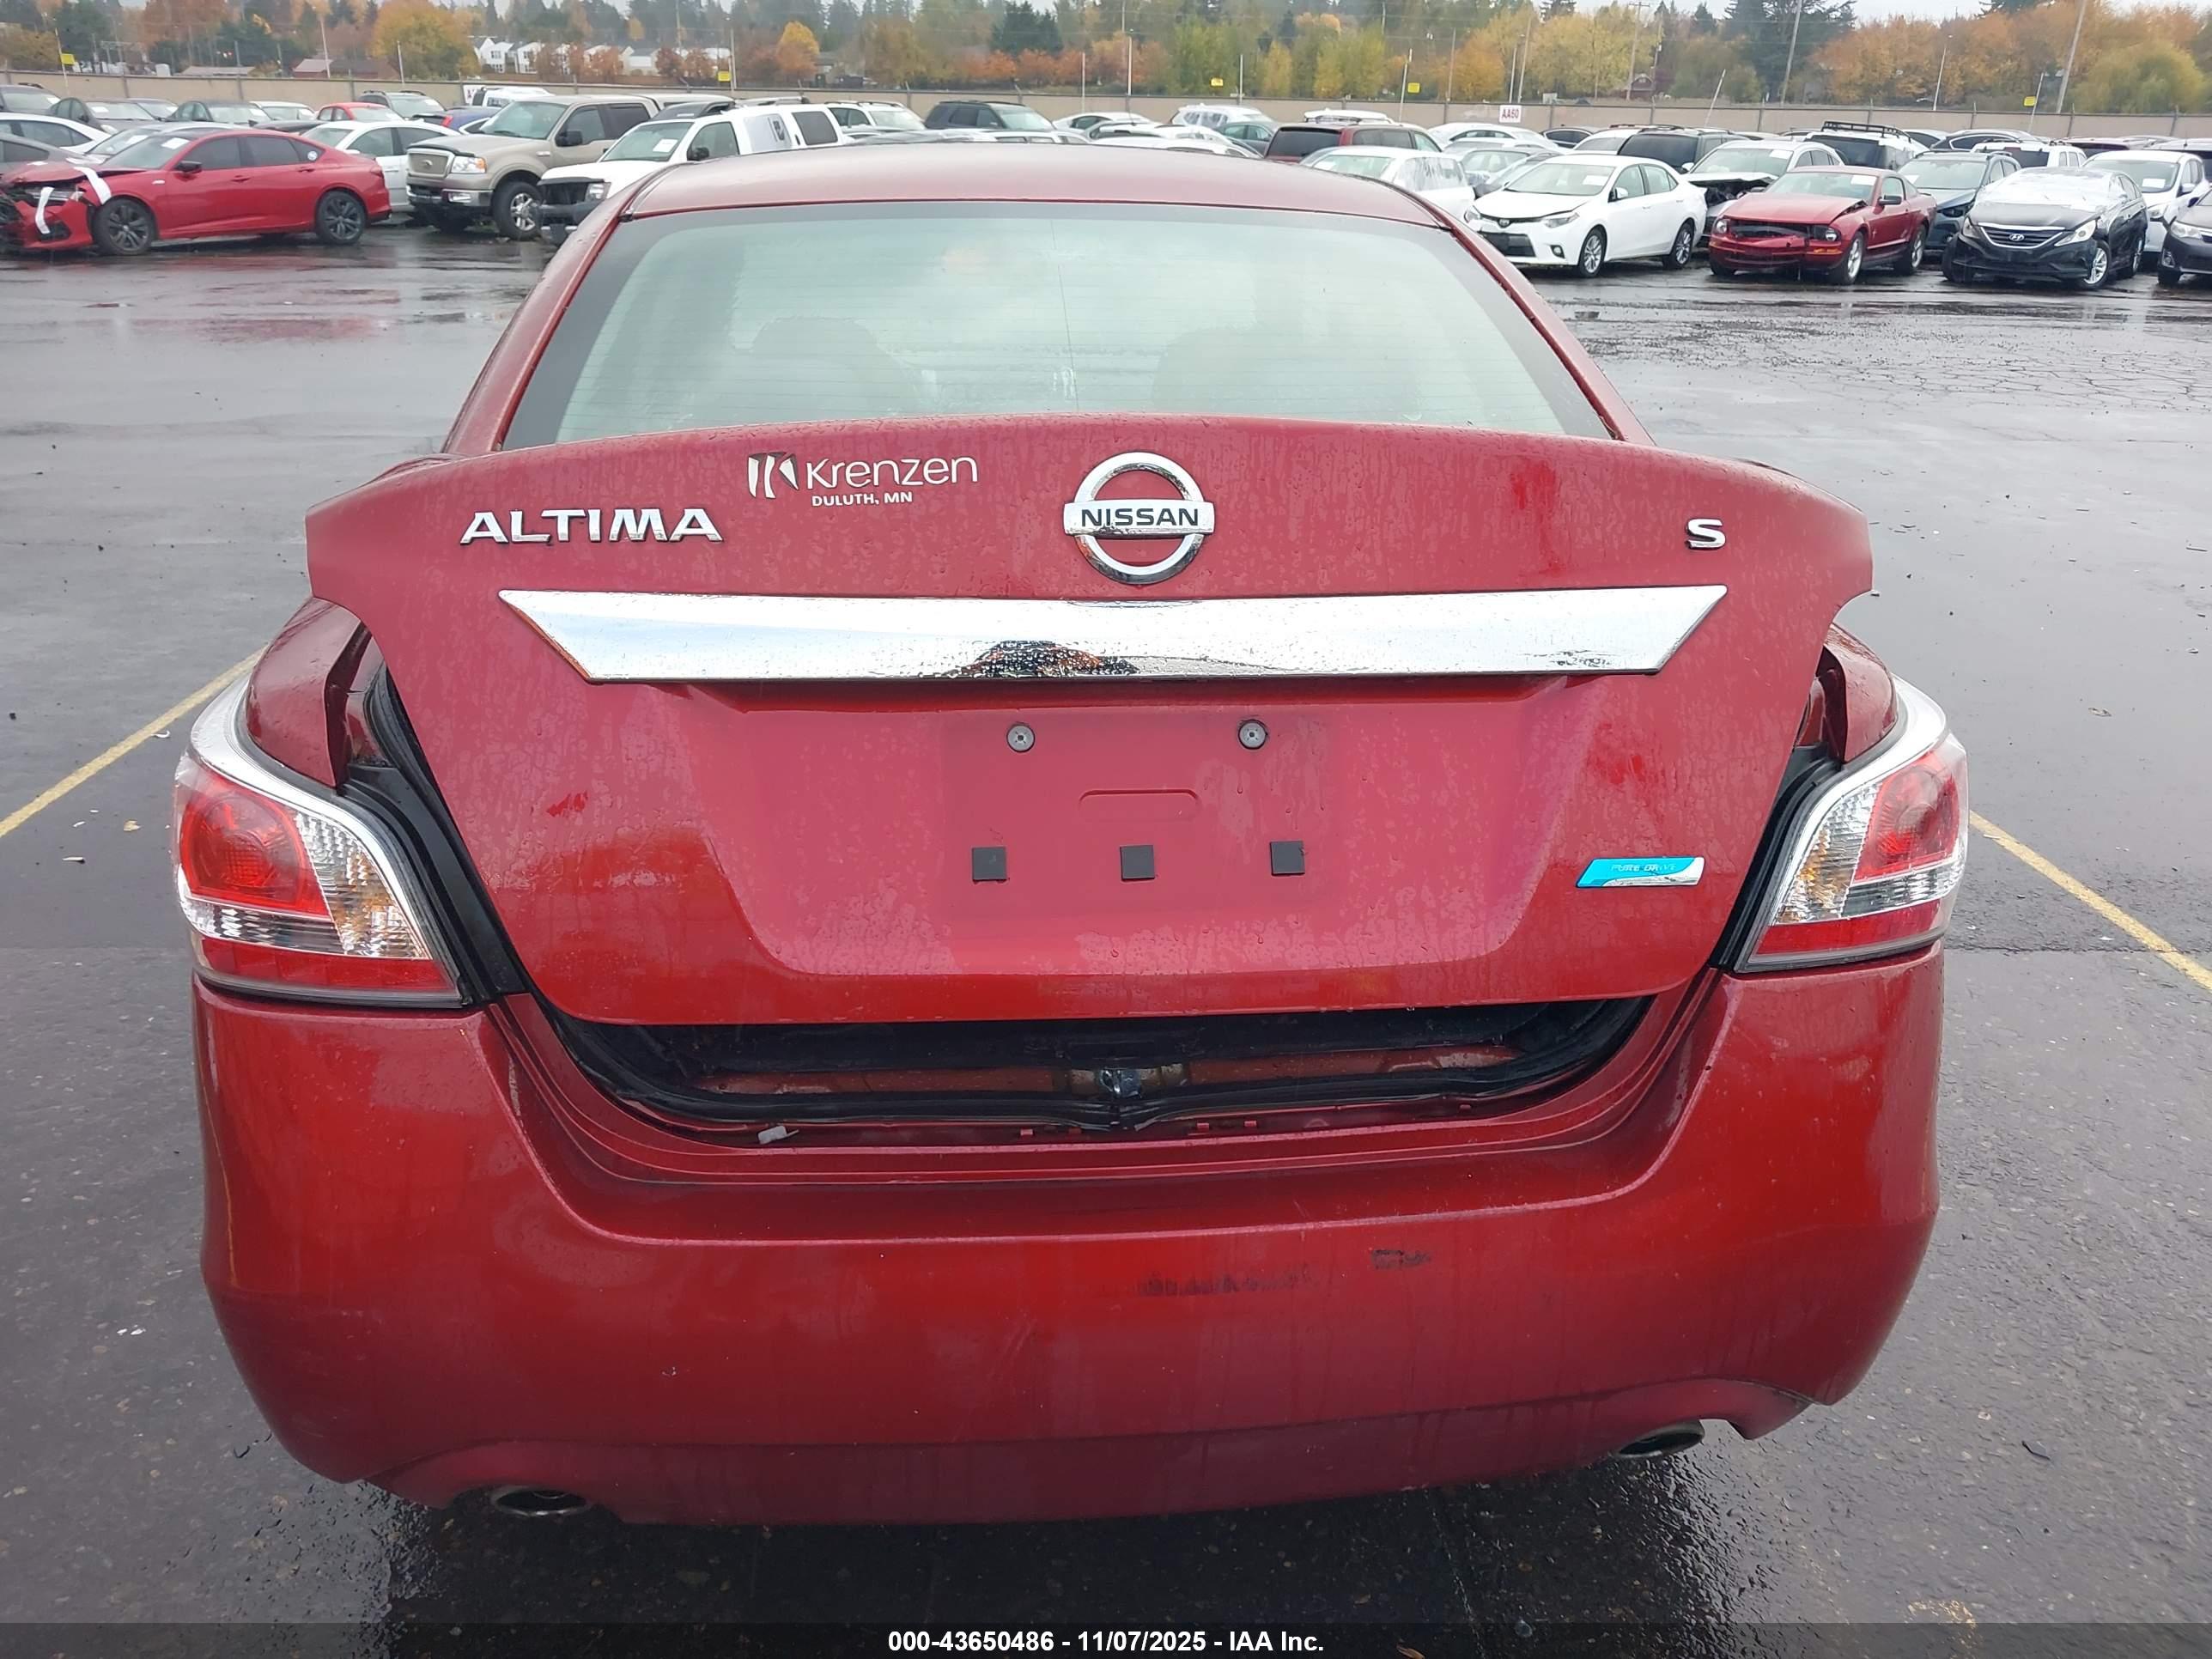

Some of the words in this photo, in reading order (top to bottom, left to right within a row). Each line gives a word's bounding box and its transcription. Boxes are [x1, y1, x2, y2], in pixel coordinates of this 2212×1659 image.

[806, 456, 978, 489] Krenzen
[811, 493, 879, 507] DULUTH,
[884, 492, 912, 503] MN
[459, 508, 724, 544] ALTIMA
[1082, 507, 1199, 527] NISSAN
[1686, 518, 1726, 550] S
